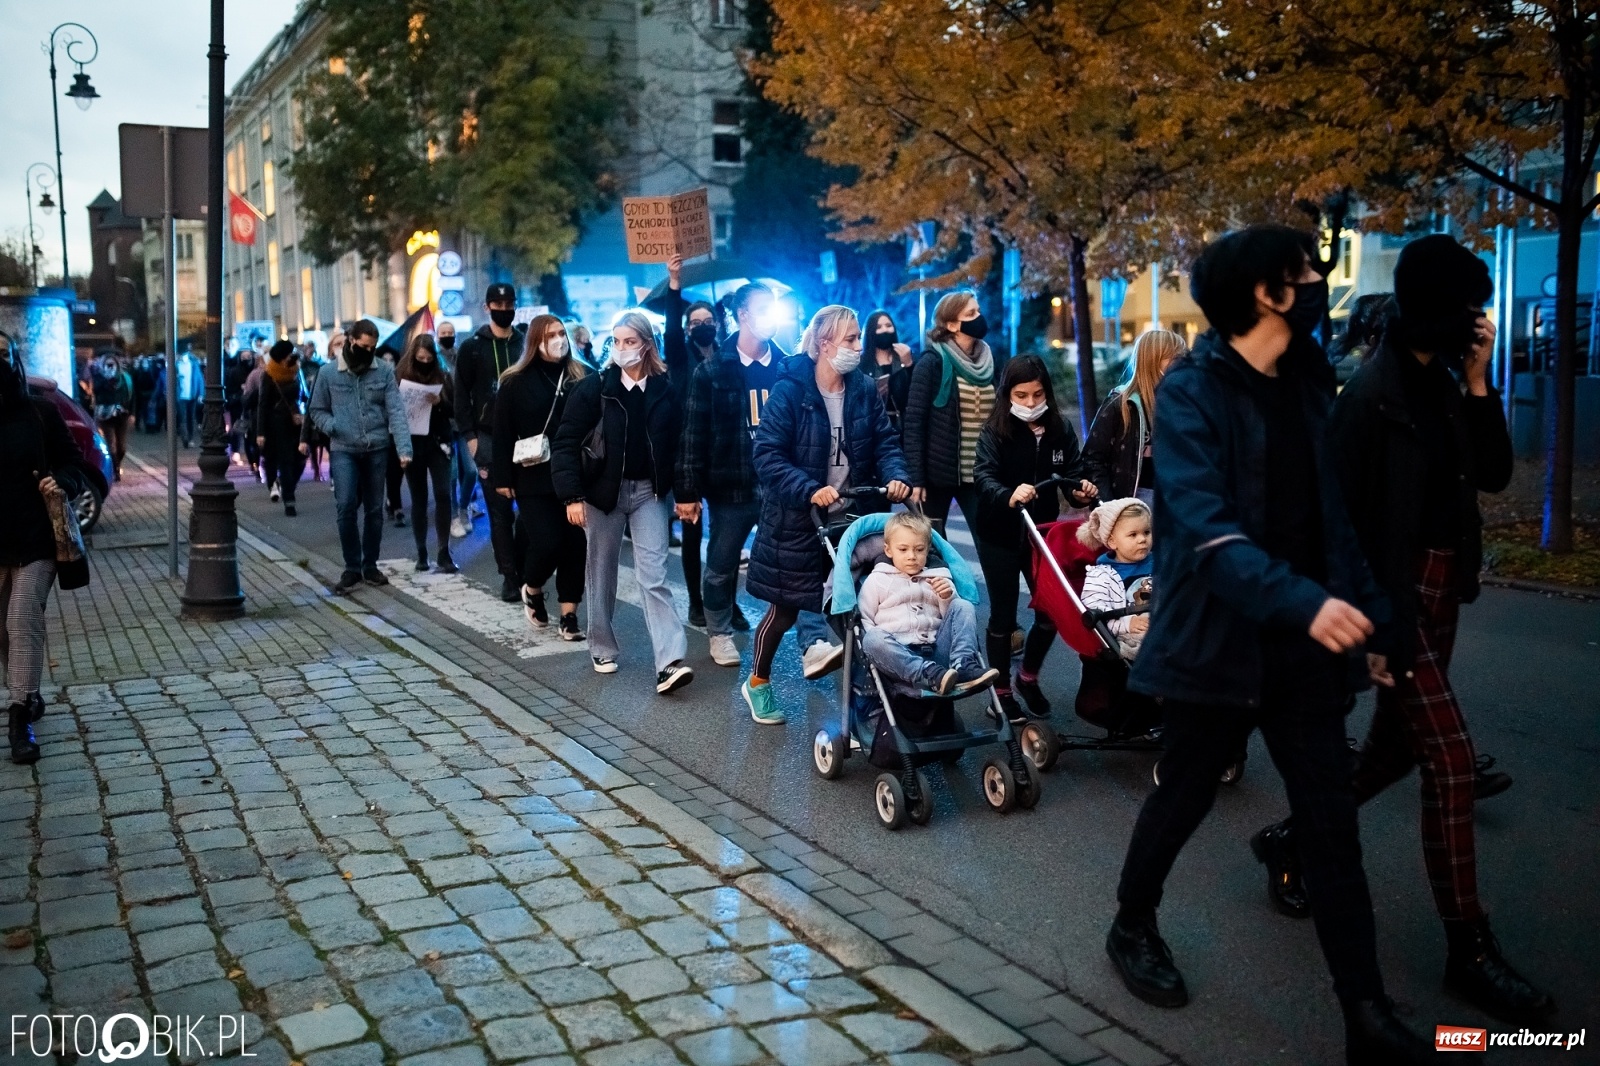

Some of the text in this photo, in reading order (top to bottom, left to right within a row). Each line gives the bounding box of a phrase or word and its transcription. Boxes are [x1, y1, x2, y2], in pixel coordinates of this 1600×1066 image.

[624, 203, 650, 216] GDYBY
[653, 202, 665, 215] TO
[627, 217, 678, 229] ZACHODZILI
[636, 232, 648, 240] TO
